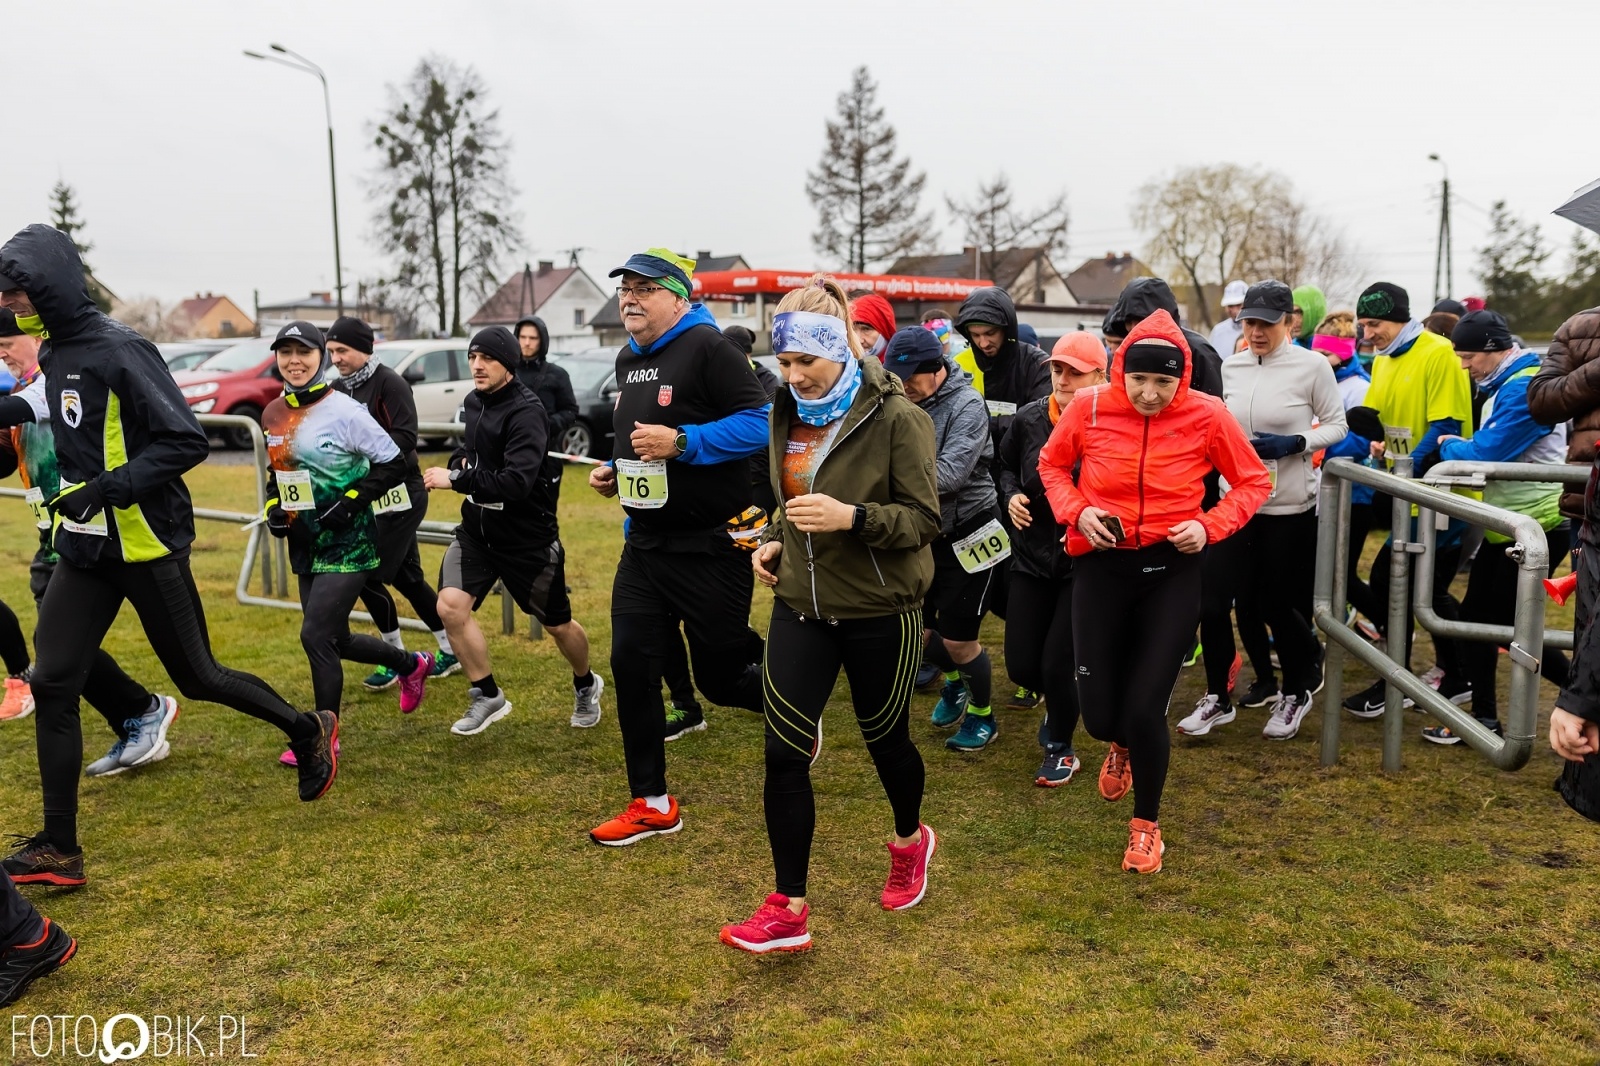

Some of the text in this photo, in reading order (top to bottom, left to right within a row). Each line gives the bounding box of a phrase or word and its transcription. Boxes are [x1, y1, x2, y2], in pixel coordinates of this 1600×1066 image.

[626, 368, 659, 384] KAROL
[626, 476, 650, 499] 76
[968, 536, 1003, 564] 119
